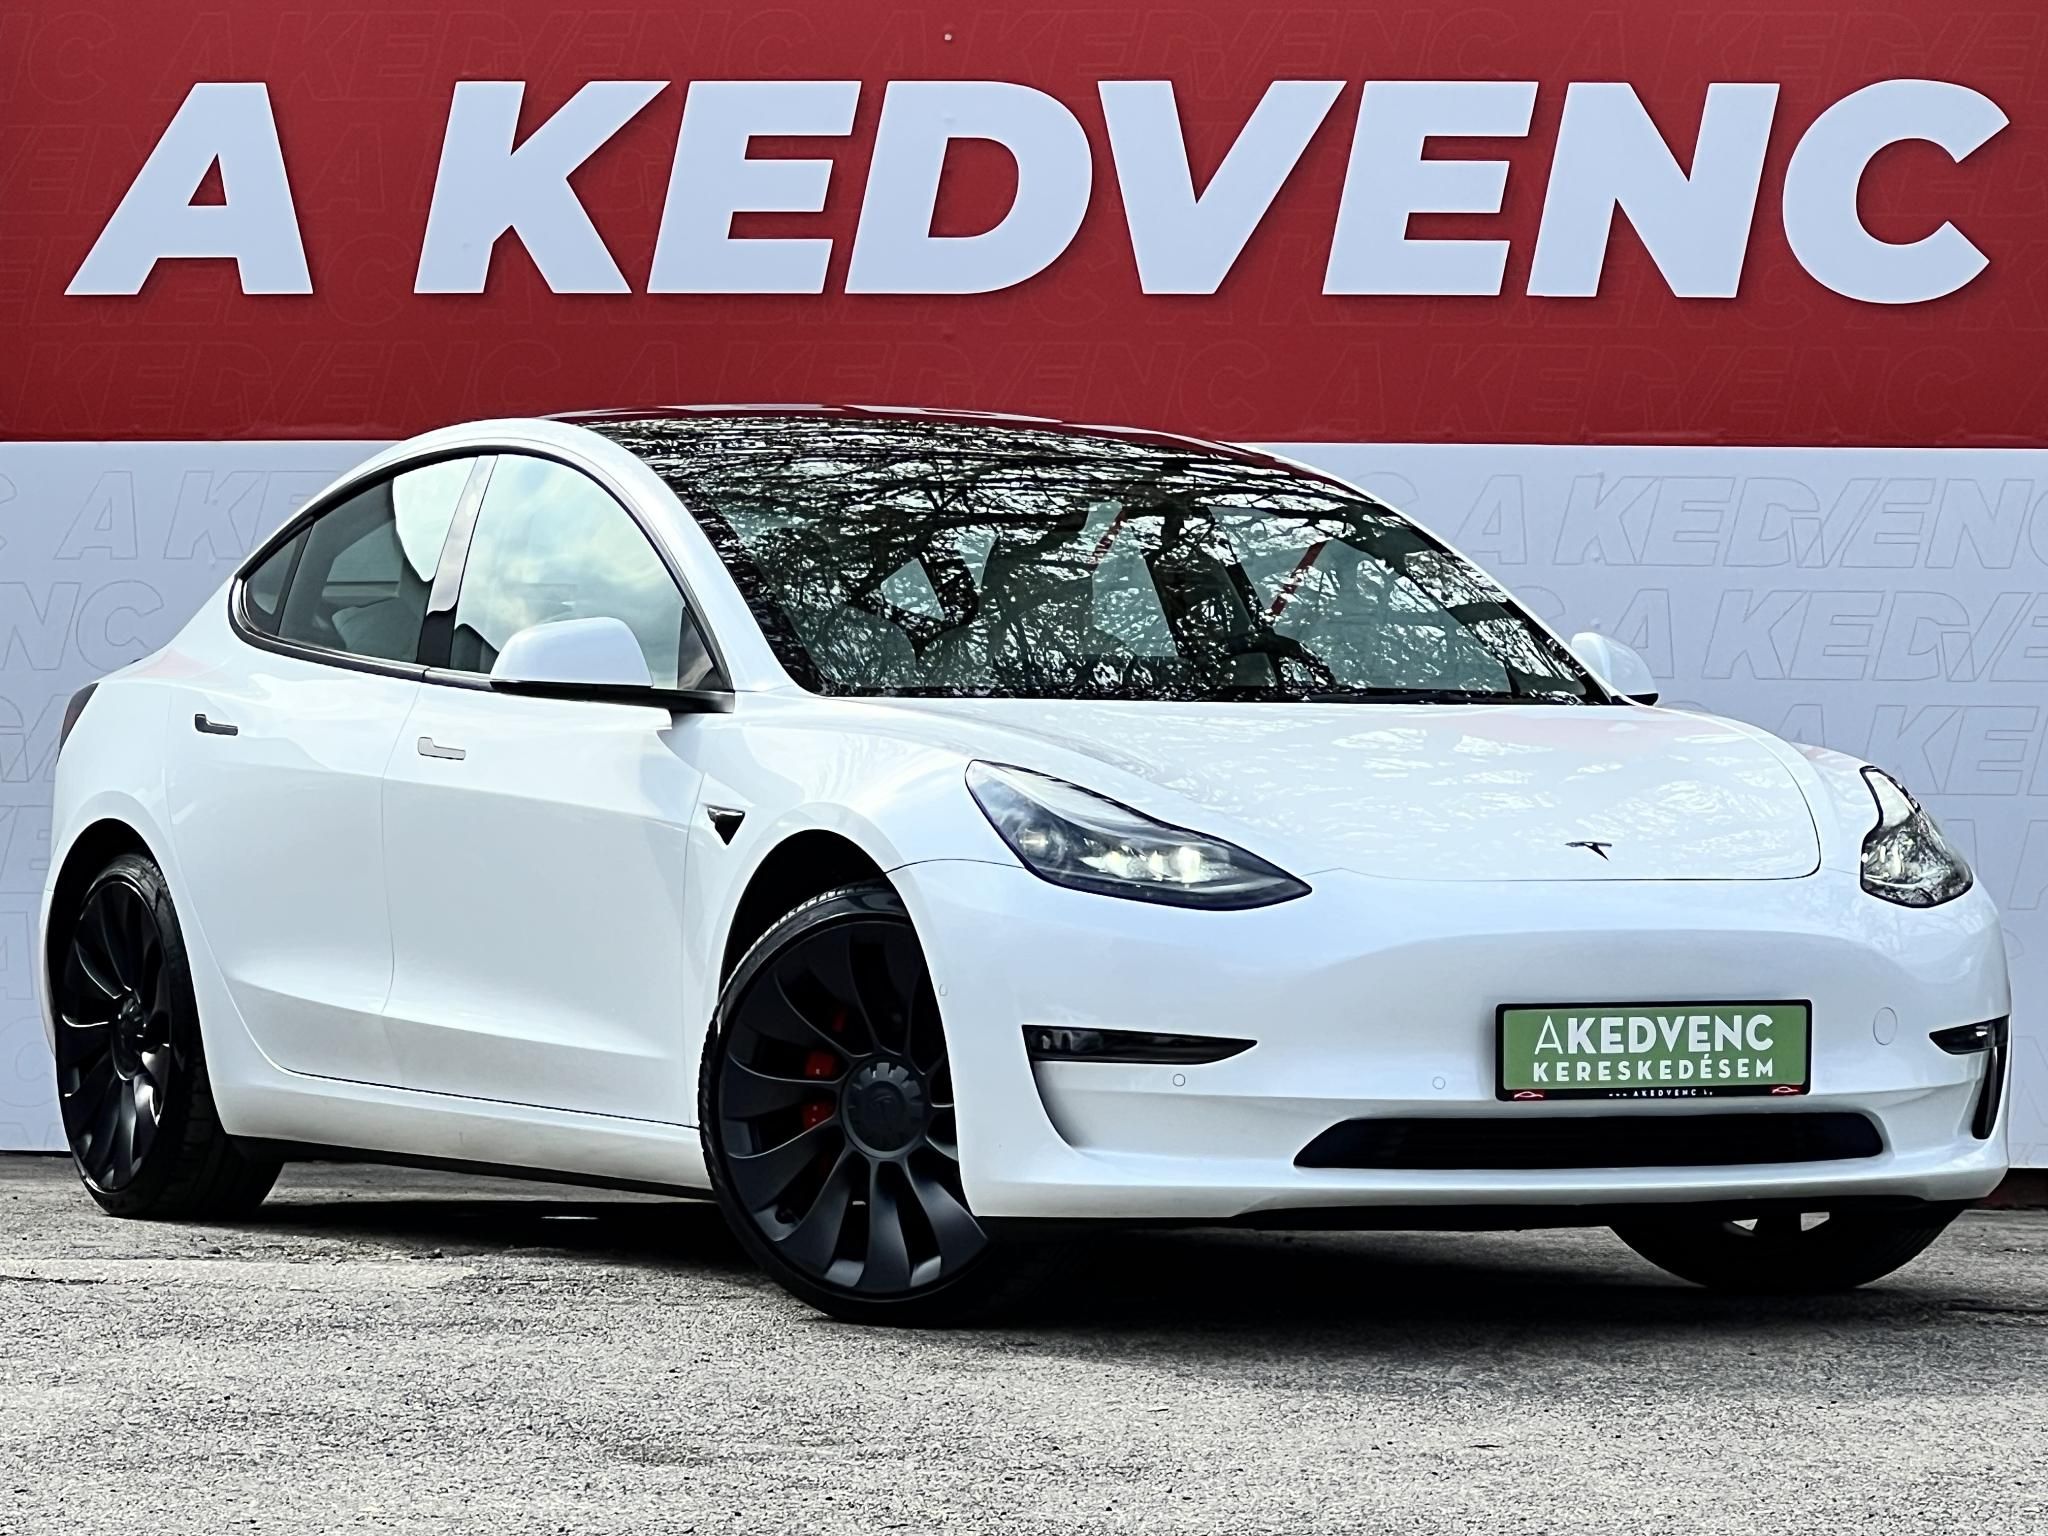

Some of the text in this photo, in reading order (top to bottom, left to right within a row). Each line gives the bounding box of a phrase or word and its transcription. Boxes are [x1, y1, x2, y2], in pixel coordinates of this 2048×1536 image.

[64, 81, 314, 297] A
[413, 79, 2011, 305] KEDVENC
[52, 470, 139, 560] A
[1454, 474, 2048, 570] A KEDVEN
[1533, 1053, 1774, 1082] KERESKEDÉSEM
